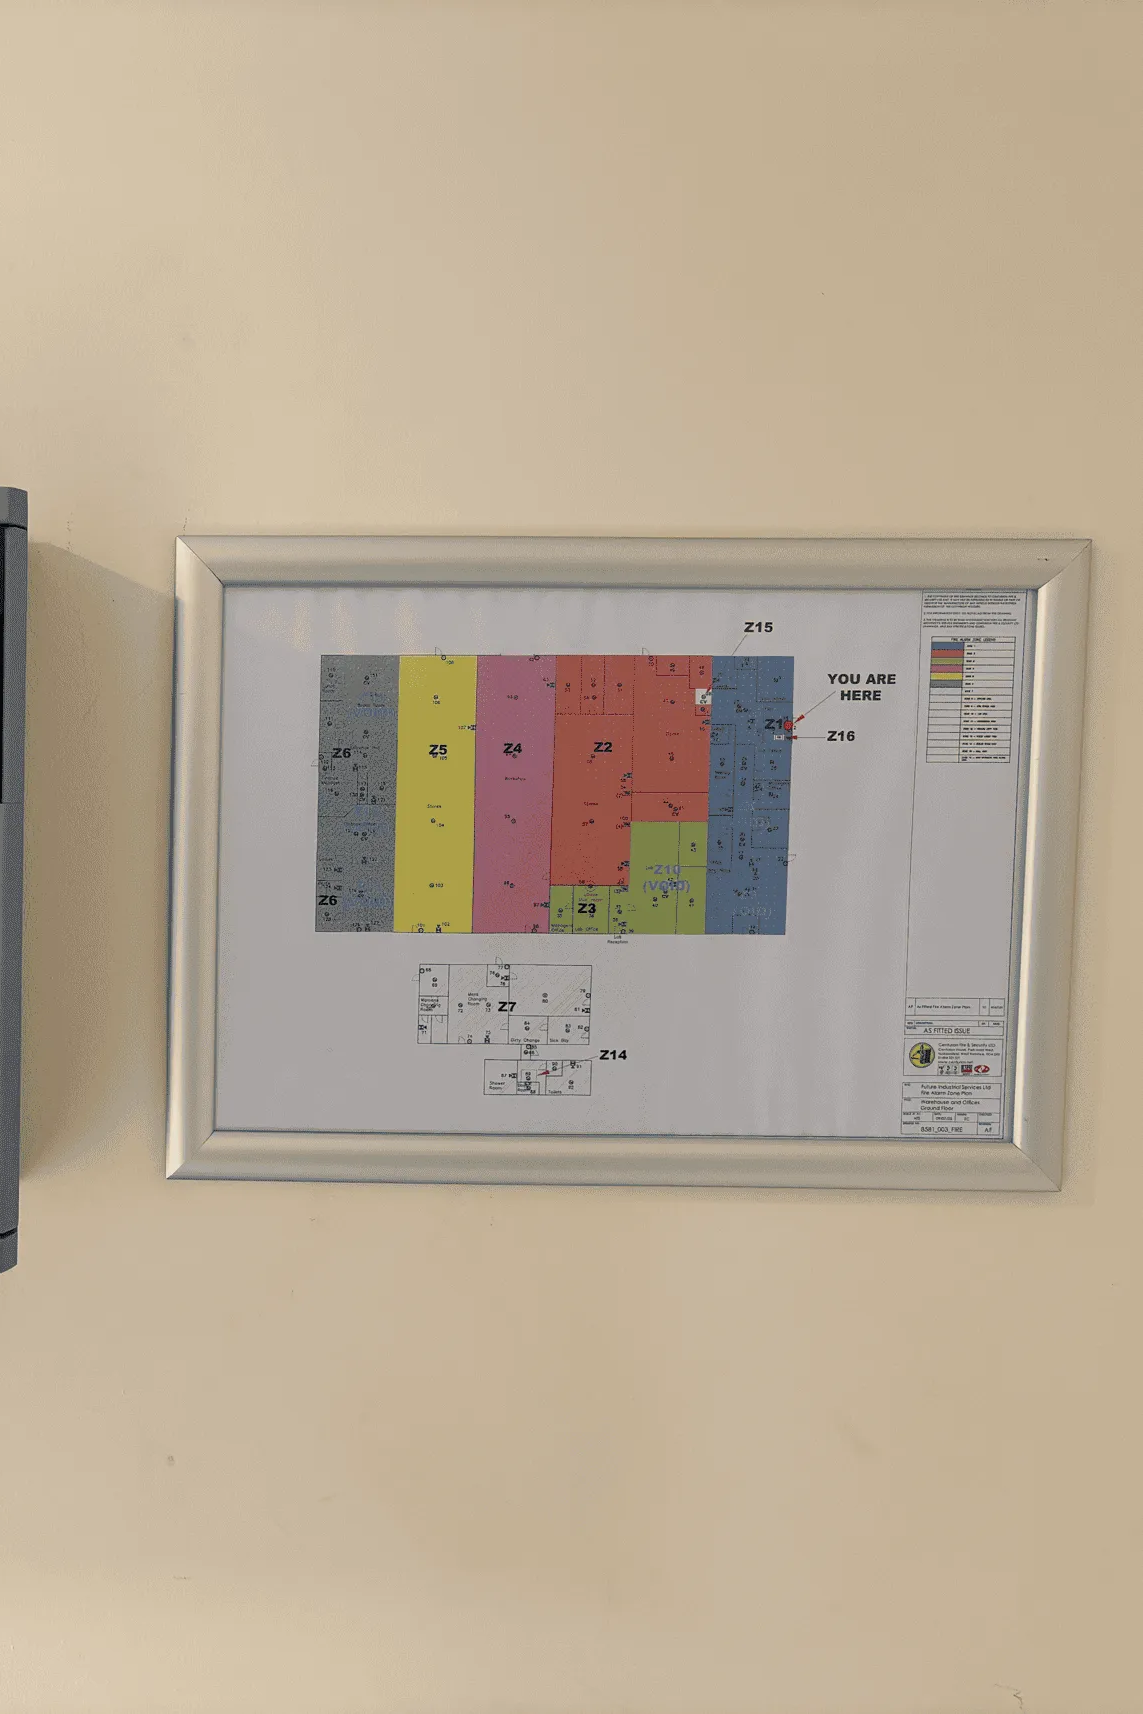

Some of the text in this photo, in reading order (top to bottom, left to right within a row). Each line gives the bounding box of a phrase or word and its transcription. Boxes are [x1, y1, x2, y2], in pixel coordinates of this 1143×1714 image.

[744, 622, 773, 633] Z15
[828, 674, 896, 685] YOU ARE
[840, 690, 881, 701] HERE
[827, 731, 855, 741] Z16
[332, 747, 351, 758] Z6
[429, 744, 447, 755] Z5
[503, 743, 522, 754] Z4
[594, 742, 613, 752] Z2
[654, 865, 681, 875] Z10
[318, 895, 338, 906] Z6
[578, 903, 596, 913] Z3
[498, 1002, 516, 1012] Z7
[600, 1050, 627, 1060] Z14
